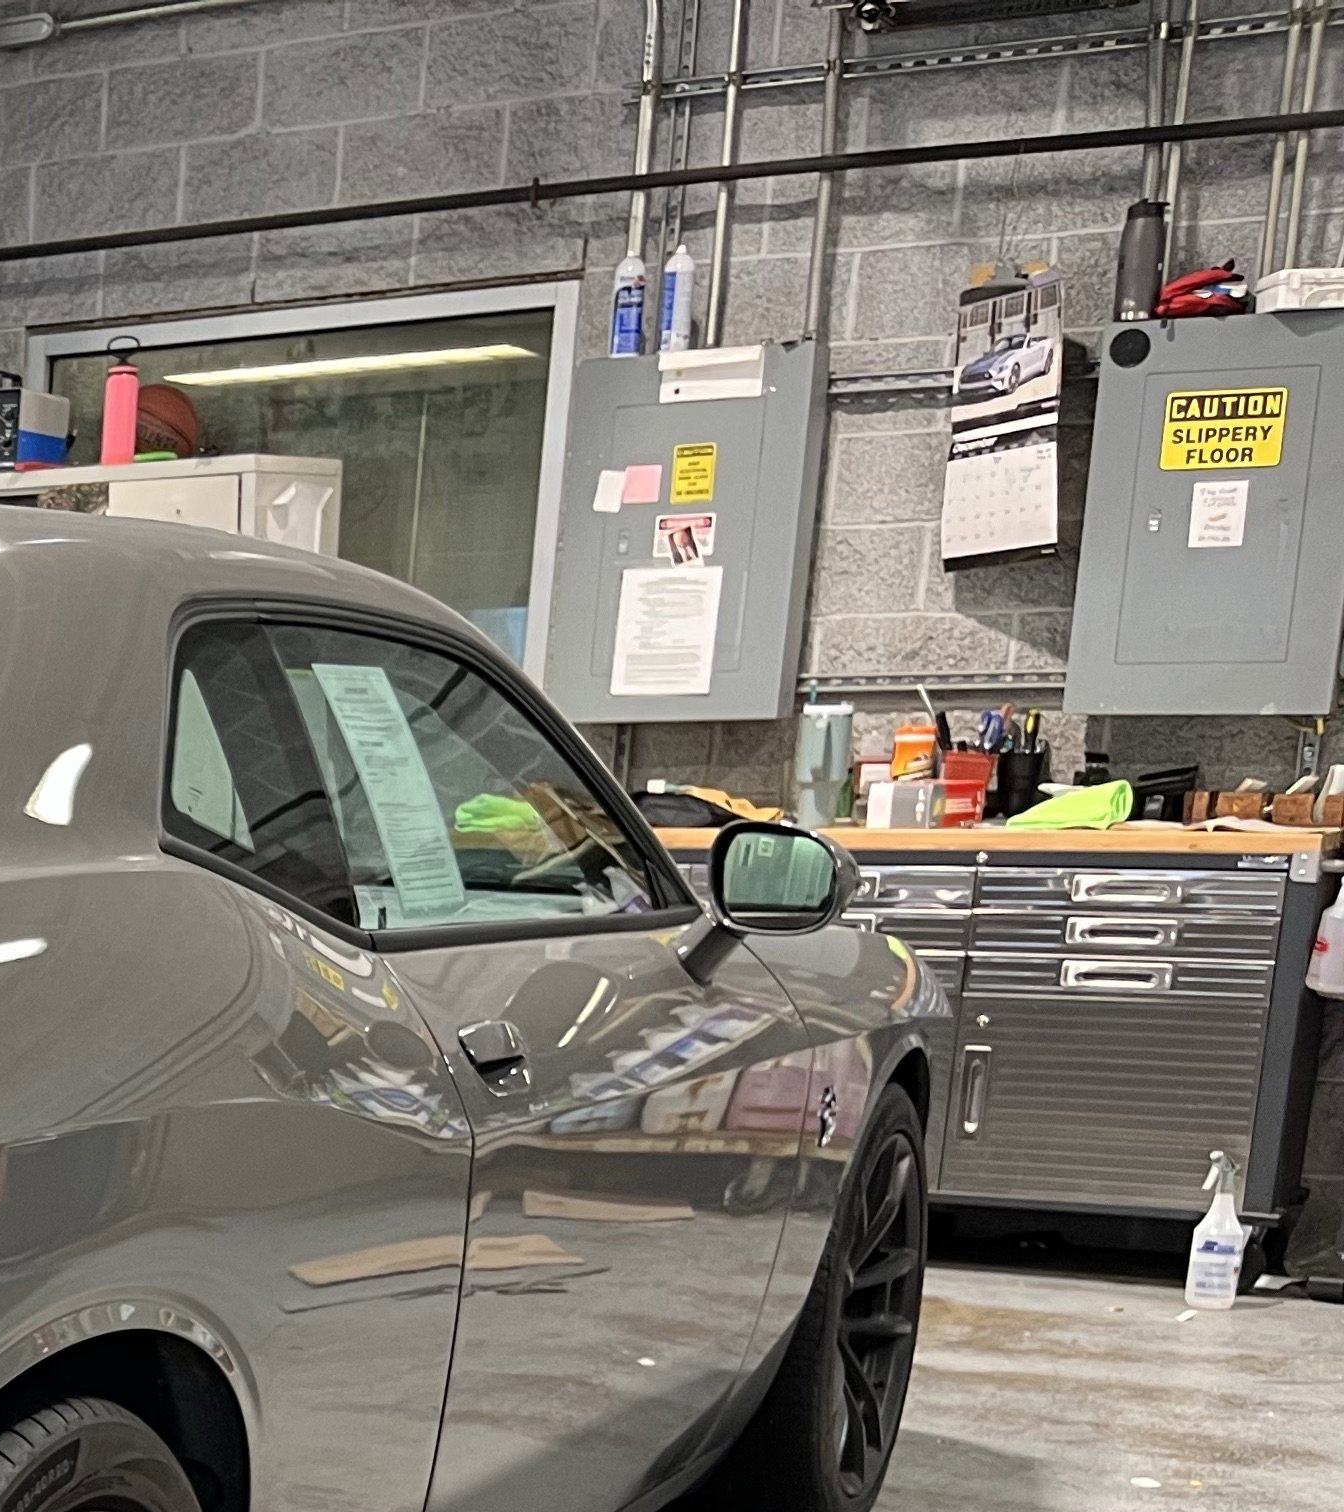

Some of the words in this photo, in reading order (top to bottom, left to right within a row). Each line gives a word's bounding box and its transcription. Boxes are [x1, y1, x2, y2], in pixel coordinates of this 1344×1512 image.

[1172, 394, 1281, 419] CAUTION
[1172, 425, 1273, 444] SLIPPERY
[1185, 447, 1253, 464] FLOOR
